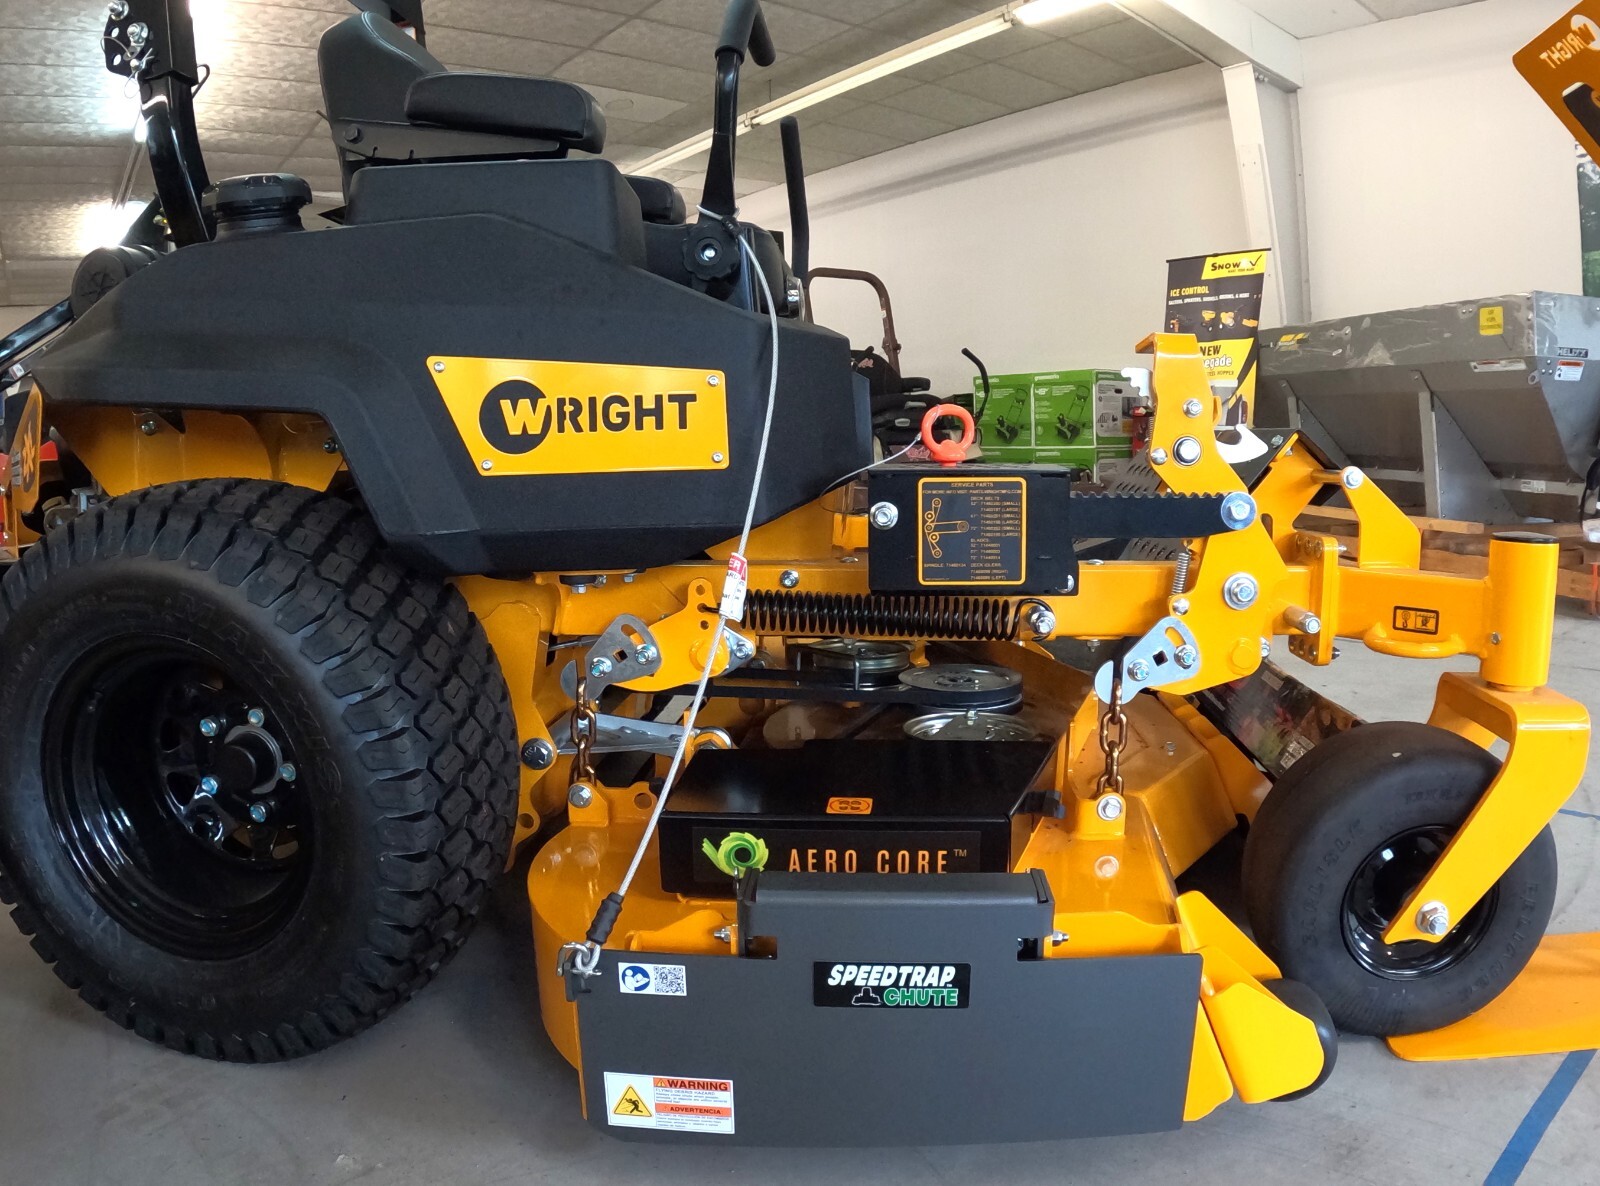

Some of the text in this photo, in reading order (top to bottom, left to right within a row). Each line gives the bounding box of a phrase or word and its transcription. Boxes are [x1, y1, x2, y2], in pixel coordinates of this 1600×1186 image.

[1170, 286, 1209, 297] ICE CONTROL
[1203, 354, 1232, 370] egade
[498, 390, 698, 436] WRIGHT
[788, 848, 858, 874] AERO
[876, 850, 948, 874] CORE
[827, 964, 956, 987] SPEEDTRAP
[883, 988, 959, 1006] CHUTE
[667, 1079, 728, 1091] WARNING
[670, 1106, 722, 1115] ADVERTENCIA
